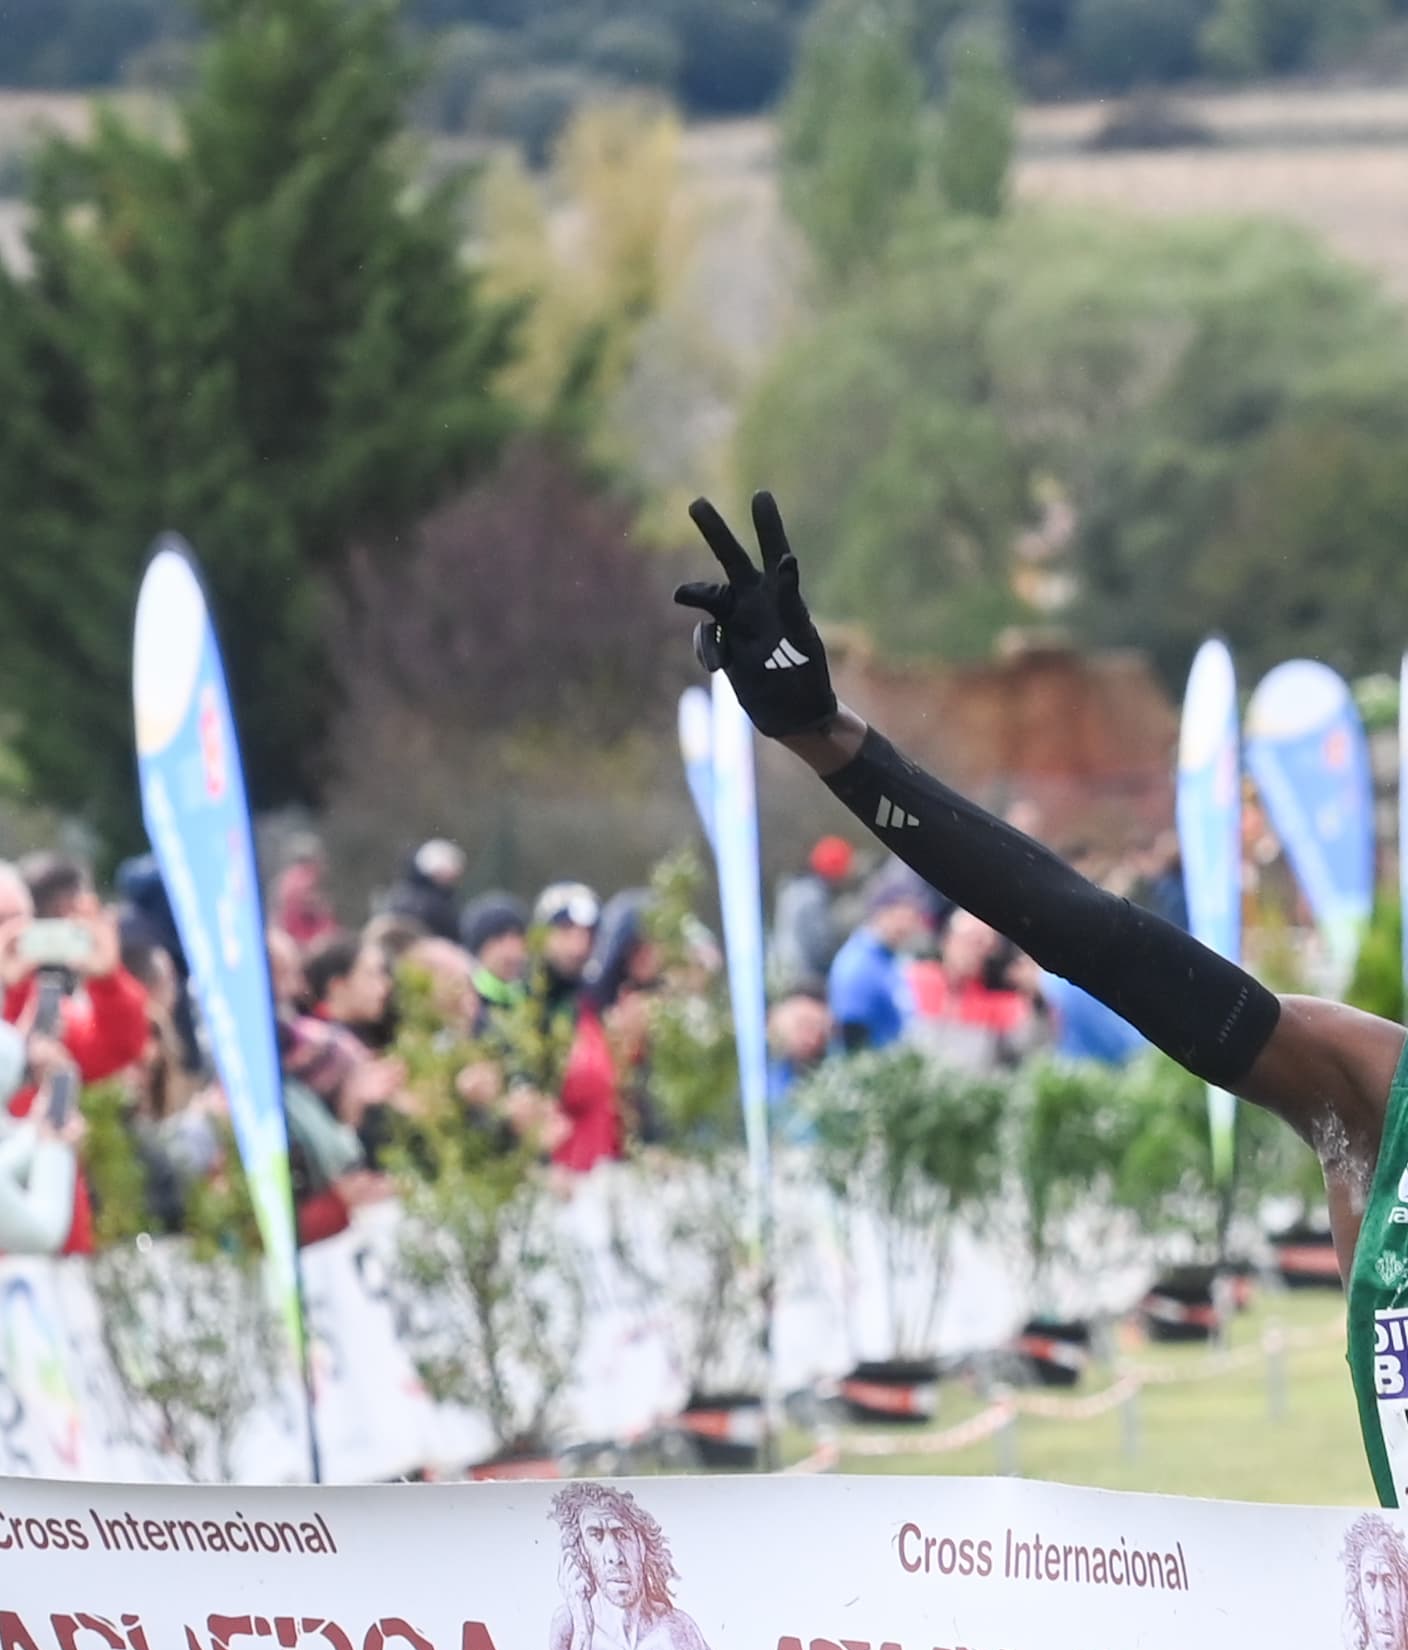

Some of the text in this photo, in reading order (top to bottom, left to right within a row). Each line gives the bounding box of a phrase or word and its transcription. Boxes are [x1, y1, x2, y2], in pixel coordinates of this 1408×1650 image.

[89, 1508, 338, 1554] Internacional
[898, 1522, 1190, 1592] Cross Internacional
